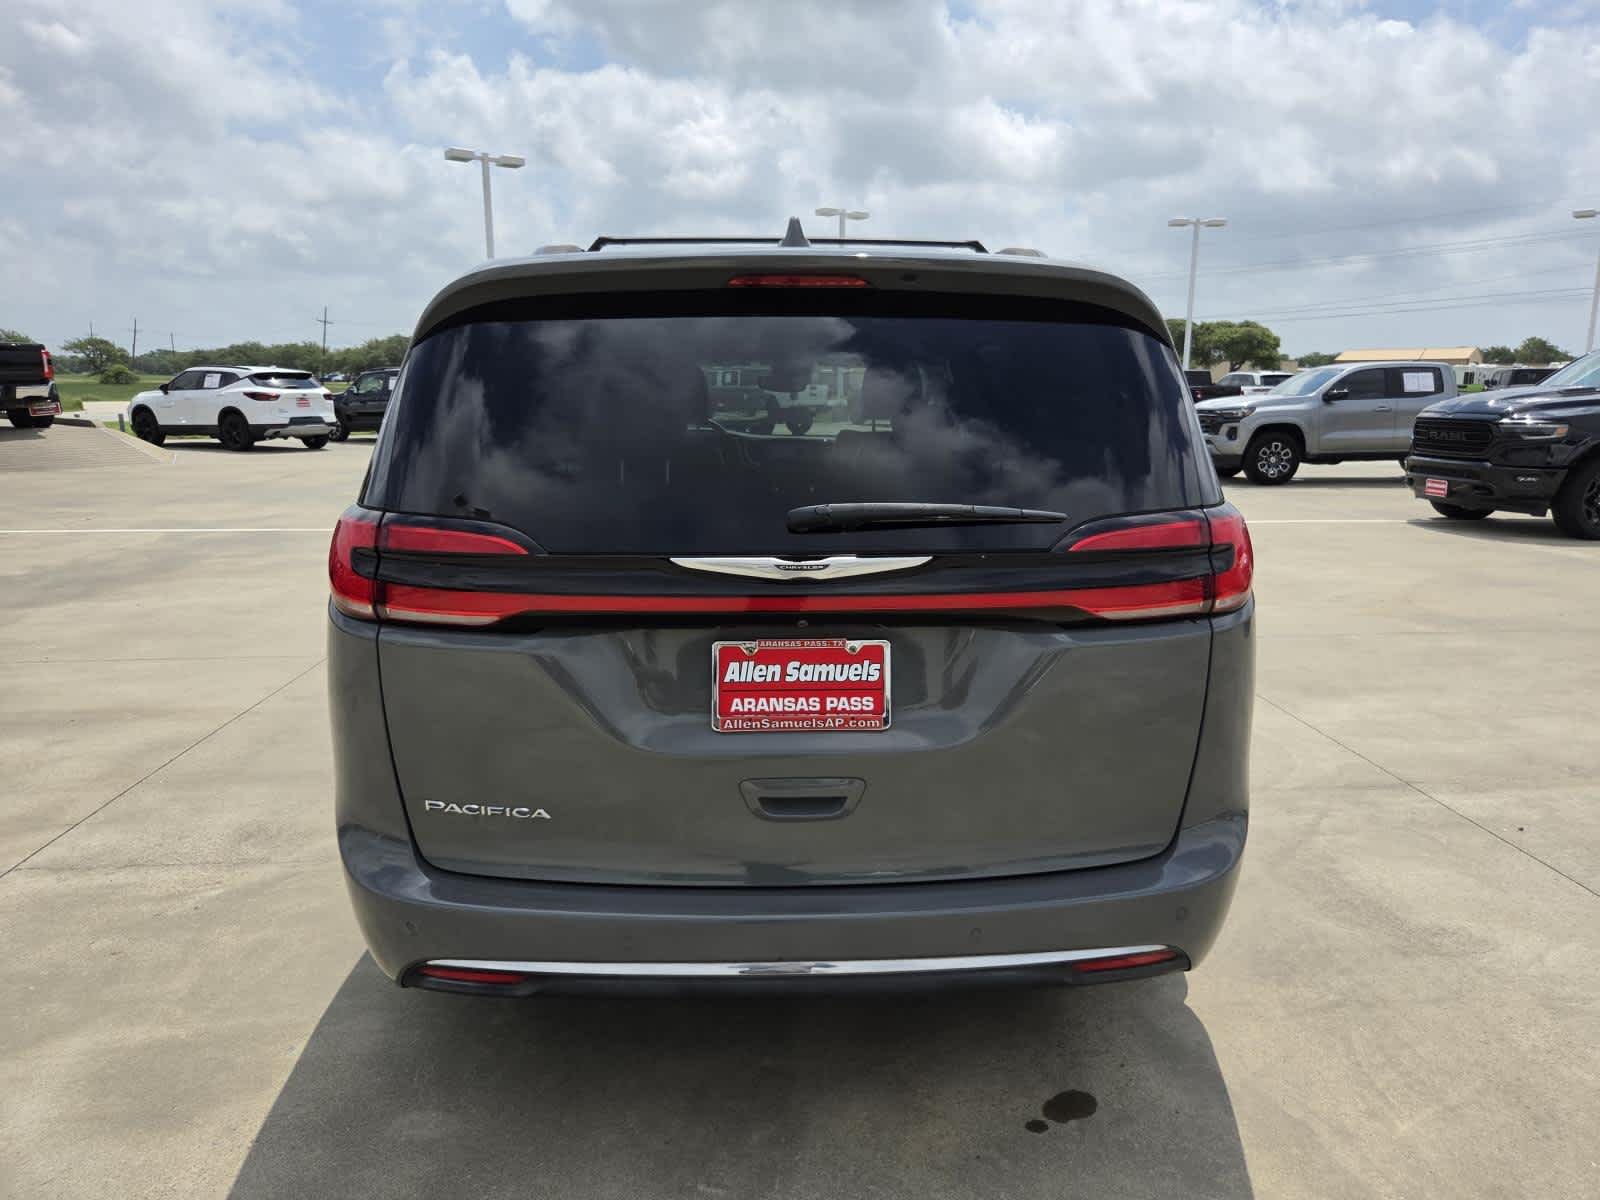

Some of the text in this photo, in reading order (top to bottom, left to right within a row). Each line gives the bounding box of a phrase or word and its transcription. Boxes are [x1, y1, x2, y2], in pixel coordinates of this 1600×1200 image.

[759, 640, 801, 648] ARANSAS
[724, 660, 881, 683] Allen Samuels
[730, 697, 875, 713] ARANSAS PASS
[723, 718, 881, 730] AllenSamuelsAP.com
[424, 799, 552, 820] PACIFICA
